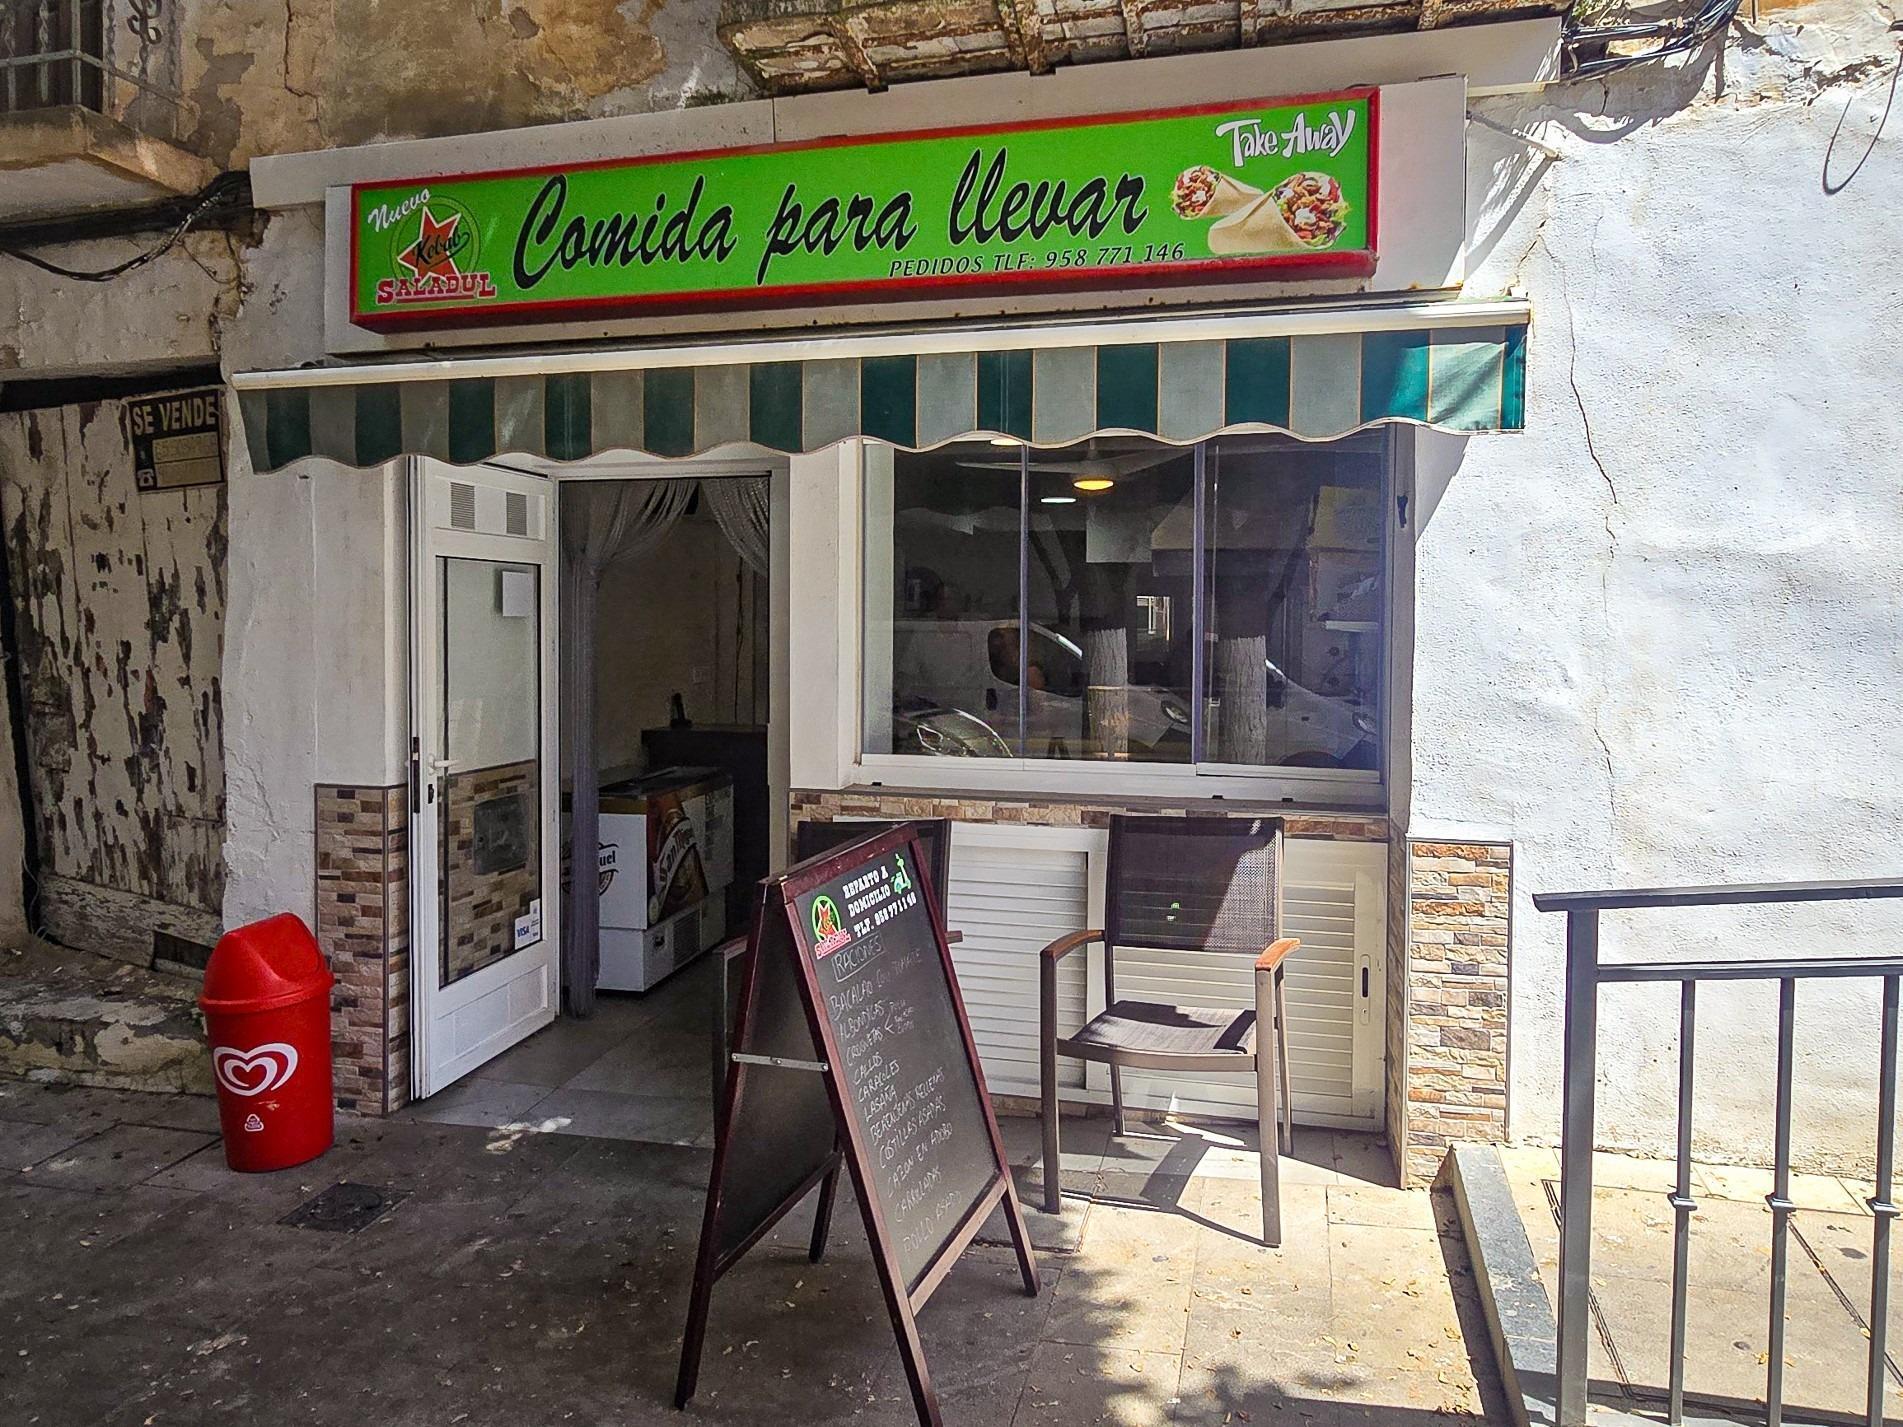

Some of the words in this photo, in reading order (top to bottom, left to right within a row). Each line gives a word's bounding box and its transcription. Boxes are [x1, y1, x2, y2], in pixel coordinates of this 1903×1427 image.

[1216, 118, 1279, 168] Take
[1283, 108, 1356, 160] Away
[367, 187, 432, 233] Nuevo
[512, 173, 738, 291] Comida
[755, 181, 919, 286] para
[947, 146, 1150, 248] llevar
[411, 228, 471, 268] Kebab
[889, 254, 983, 278] PEDIDOS
[993, 251, 1036, 271] TLF:
[1045, 248, 1087, 268] 958
[1096, 246, 1133, 266] 771
[1143, 242, 1185, 262] 146
[375, 272, 497, 305] SALADUL
[132, 405, 154, 435] SE
[159, 396, 217, 431] VENDE
[842, 869, 880, 899] REPARTO
[880, 865, 889, 880] A
[847, 884, 891, 918] DOMICILIO
[516, 925, 530, 938] VISA
[834, 935, 882, 977] RACIONES
[829, 980, 873, 1021] BACALAO
[853, 1051, 883, 1086] CALLOS
[858, 1059, 900, 1103] CARACOLES
[916, 1142, 928, 1162] EN
